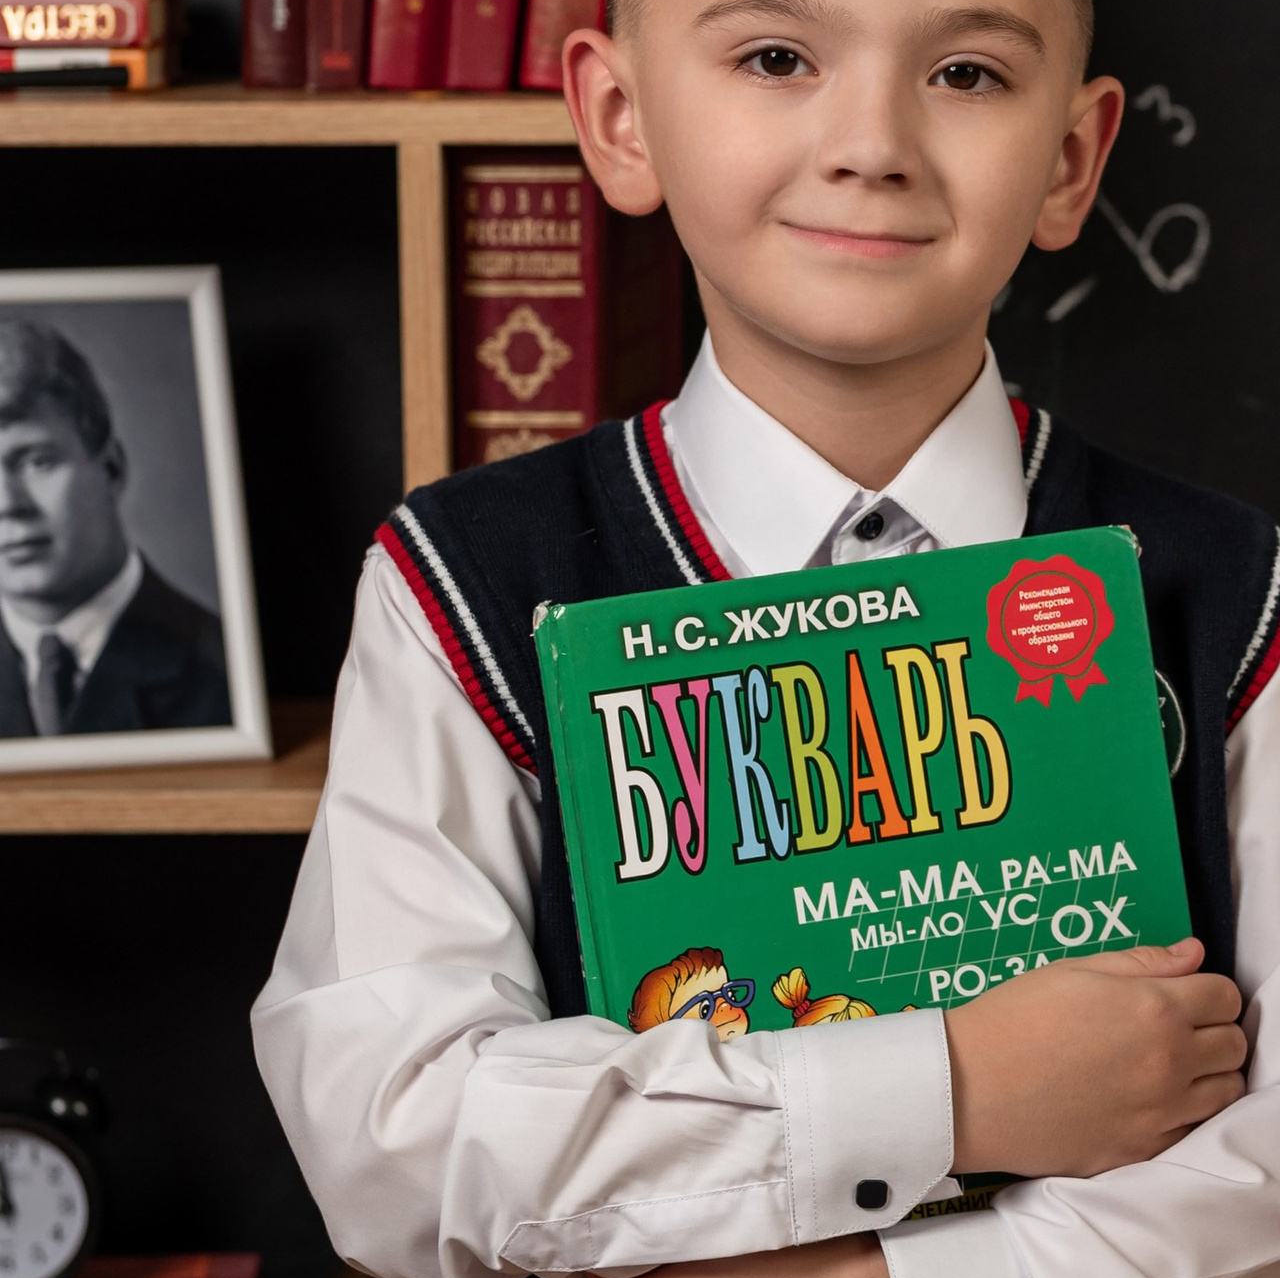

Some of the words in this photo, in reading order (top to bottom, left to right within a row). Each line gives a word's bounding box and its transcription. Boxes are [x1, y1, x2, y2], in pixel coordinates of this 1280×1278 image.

[1019, 586, 1071, 600] Рекомендован
[1019, 597, 1074, 611] Министерством
[622, 623, 667, 659] Н.
[674, 617, 718, 652] С.
[724, 586, 920, 644] ЖУКОВА
[1033, 610, 1061, 621] общего
[1028, 632, 1075, 645] образования
[1046, 644, 1059, 654] РФ
[589, 637, 1012, 883] БУКВАРЬ
[793, 861, 984, 924] МА-МА
[1001, 841, 1137, 891] РА-МА
[850, 912, 963, 952] МЫ-ЛО
[980, 893, 1039, 930] УС
[1051, 896, 1135, 947] ОХ
